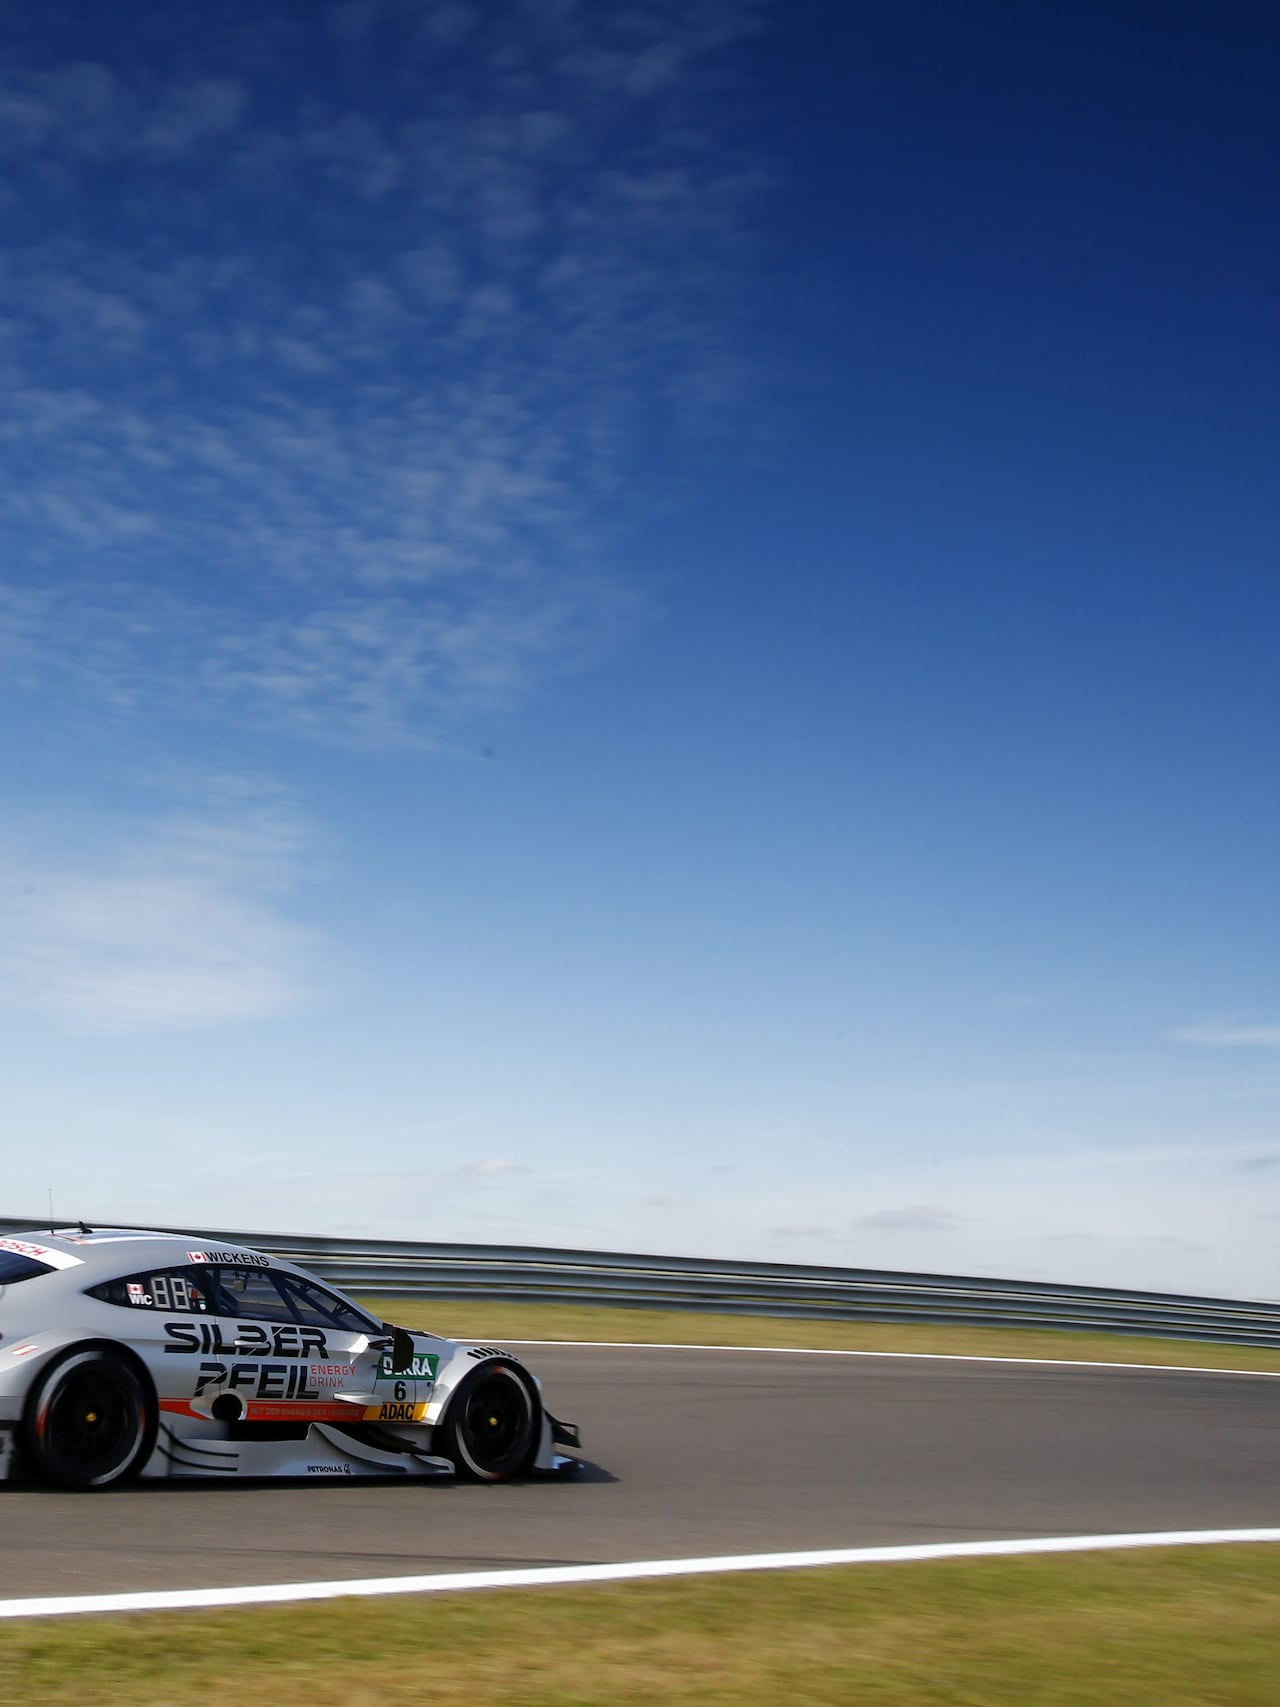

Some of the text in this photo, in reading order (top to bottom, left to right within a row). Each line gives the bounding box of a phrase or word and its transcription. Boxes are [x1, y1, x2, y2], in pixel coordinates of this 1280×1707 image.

[205, 1251, 270, 1267] WICKENS
[128, 1293, 153, 1305] WIC
[163, 1322, 330, 1359] SILBER
[310, 1364, 356, 1376] ENERGY
[383, 1356, 434, 1377] DRA
[194, 1362, 320, 1400] PFEIL
[309, 1376, 345, 1388] DRINK
[394, 1380, 406, 1401] 6
[378, 1403, 415, 1420] ADAC
[307, 1465, 343, 1473] PETRONAS
